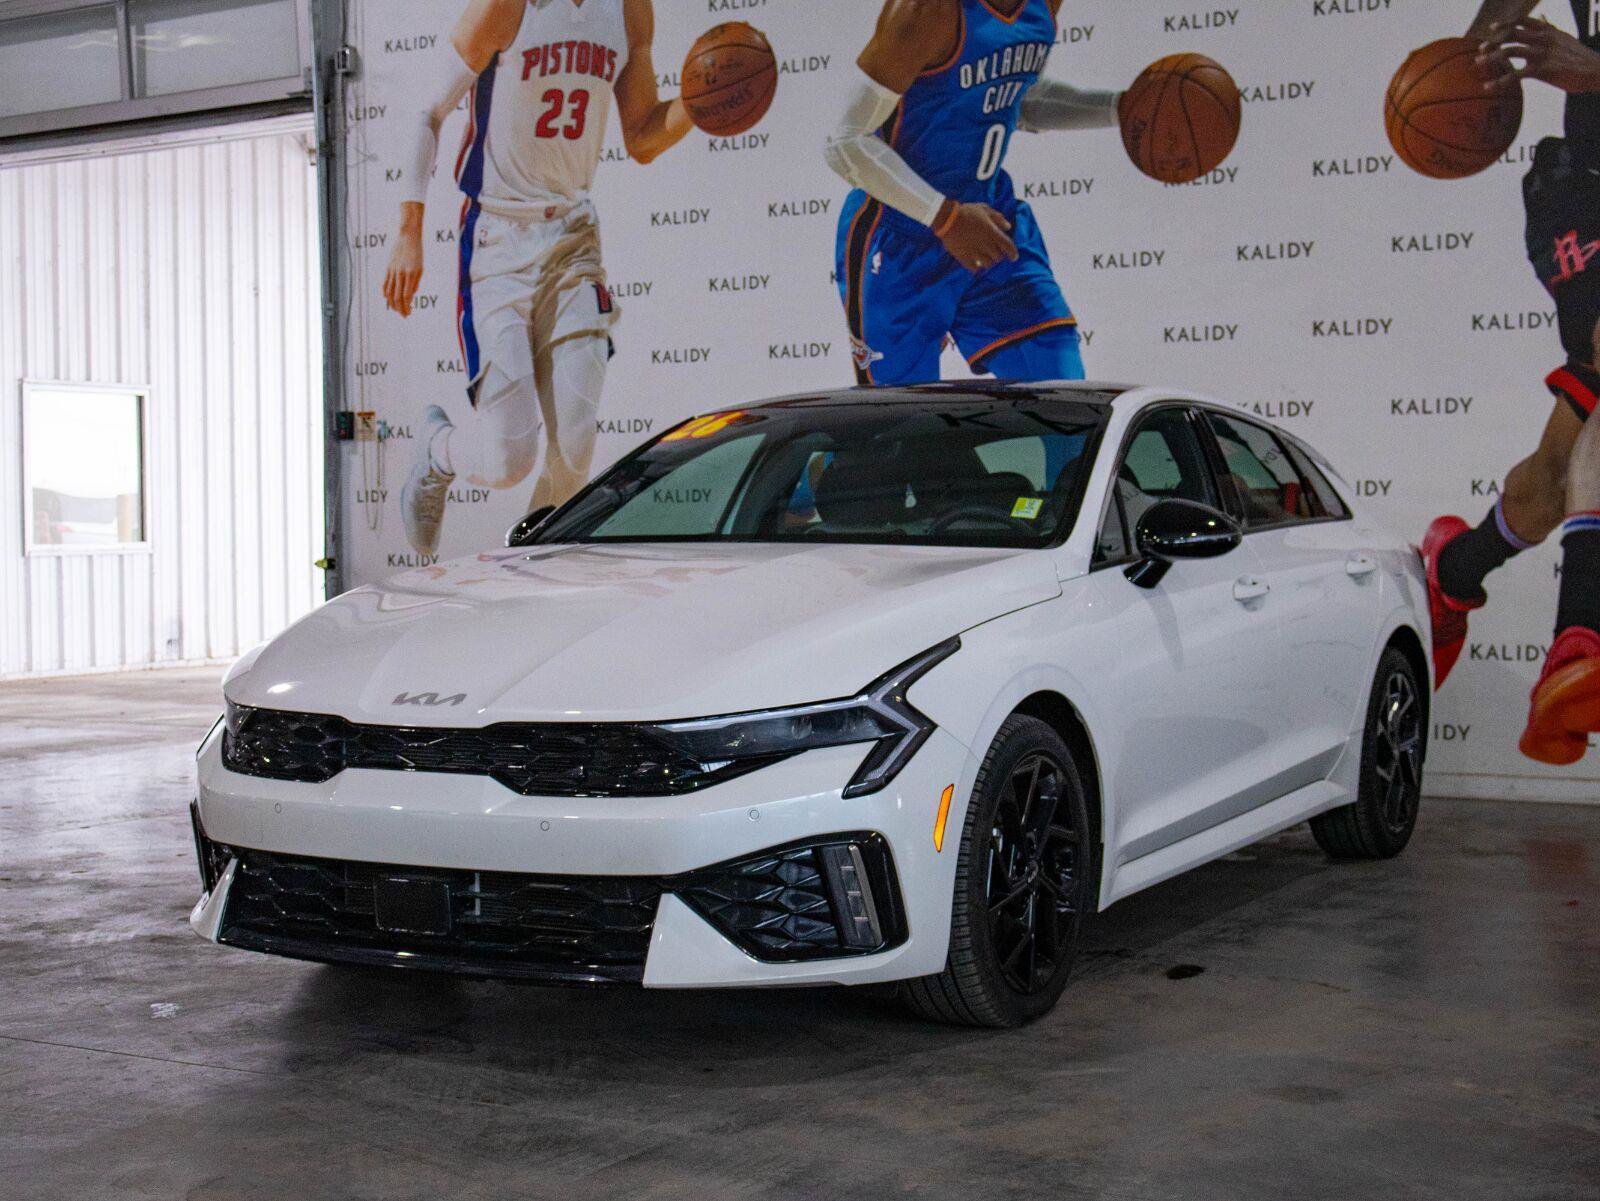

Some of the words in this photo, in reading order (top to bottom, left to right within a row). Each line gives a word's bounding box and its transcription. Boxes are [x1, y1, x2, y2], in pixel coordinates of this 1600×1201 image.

[1164, 10, 1239, 32] KALIDY
[1062, 25, 1094, 43] IDY
[384, 35, 437, 53] KALIDY
[521, 40, 618, 82] PISTONS
[780, 54, 830, 74] ALIDY
[960, 43, 1048, 89] OKLAHOM
[983, 82, 1023, 114] CITY
[355, 104, 387, 121] LIDY
[535, 88, 590, 140] 23
[708, 134, 769, 152] KALIDY
[976, 123, 1006, 181] 0
[1313, 156, 1393, 176] KALIDY
[1024, 179, 1094, 197] KALIDY
[768, 199, 831, 217] KALIDY
[651, 209, 710, 226] KALIDY
[355, 234, 387, 249] LIDY
[1391, 232, 1474, 252] KALIDY
[1093, 251, 1165, 269] KALIDY
[1237, 241, 1314, 261] KALIDY
[609, 281, 652, 298] ALIDY
[708, 275, 770, 291] KALIDY
[1312, 318, 1393, 337] KALIDY
[1472, 311, 1556, 331] KALIDY
[1164, 325, 1238, 343] KALIDY
[652, 348, 711, 364] KALIDY
[768, 343, 831, 359] KALIDY
[356, 361, 388, 376] LIDY
[437, 359, 464, 373] KAL
[1252, 401, 1313, 418] ALIDY
[1391, 397, 1473, 415] KALIDY
[388, 426, 413, 439] KAL
[596, 419, 653, 433] KALIDY
[356, 490, 388, 503] LIDY
[448, 489, 490, 503] ALIDY
[653, 489, 712, 503] KALIDY
[1356, 480, 1391, 496] IDY
[387, 554, 439, 567] KALIDY
[1433, 724, 1471, 741] IDY
